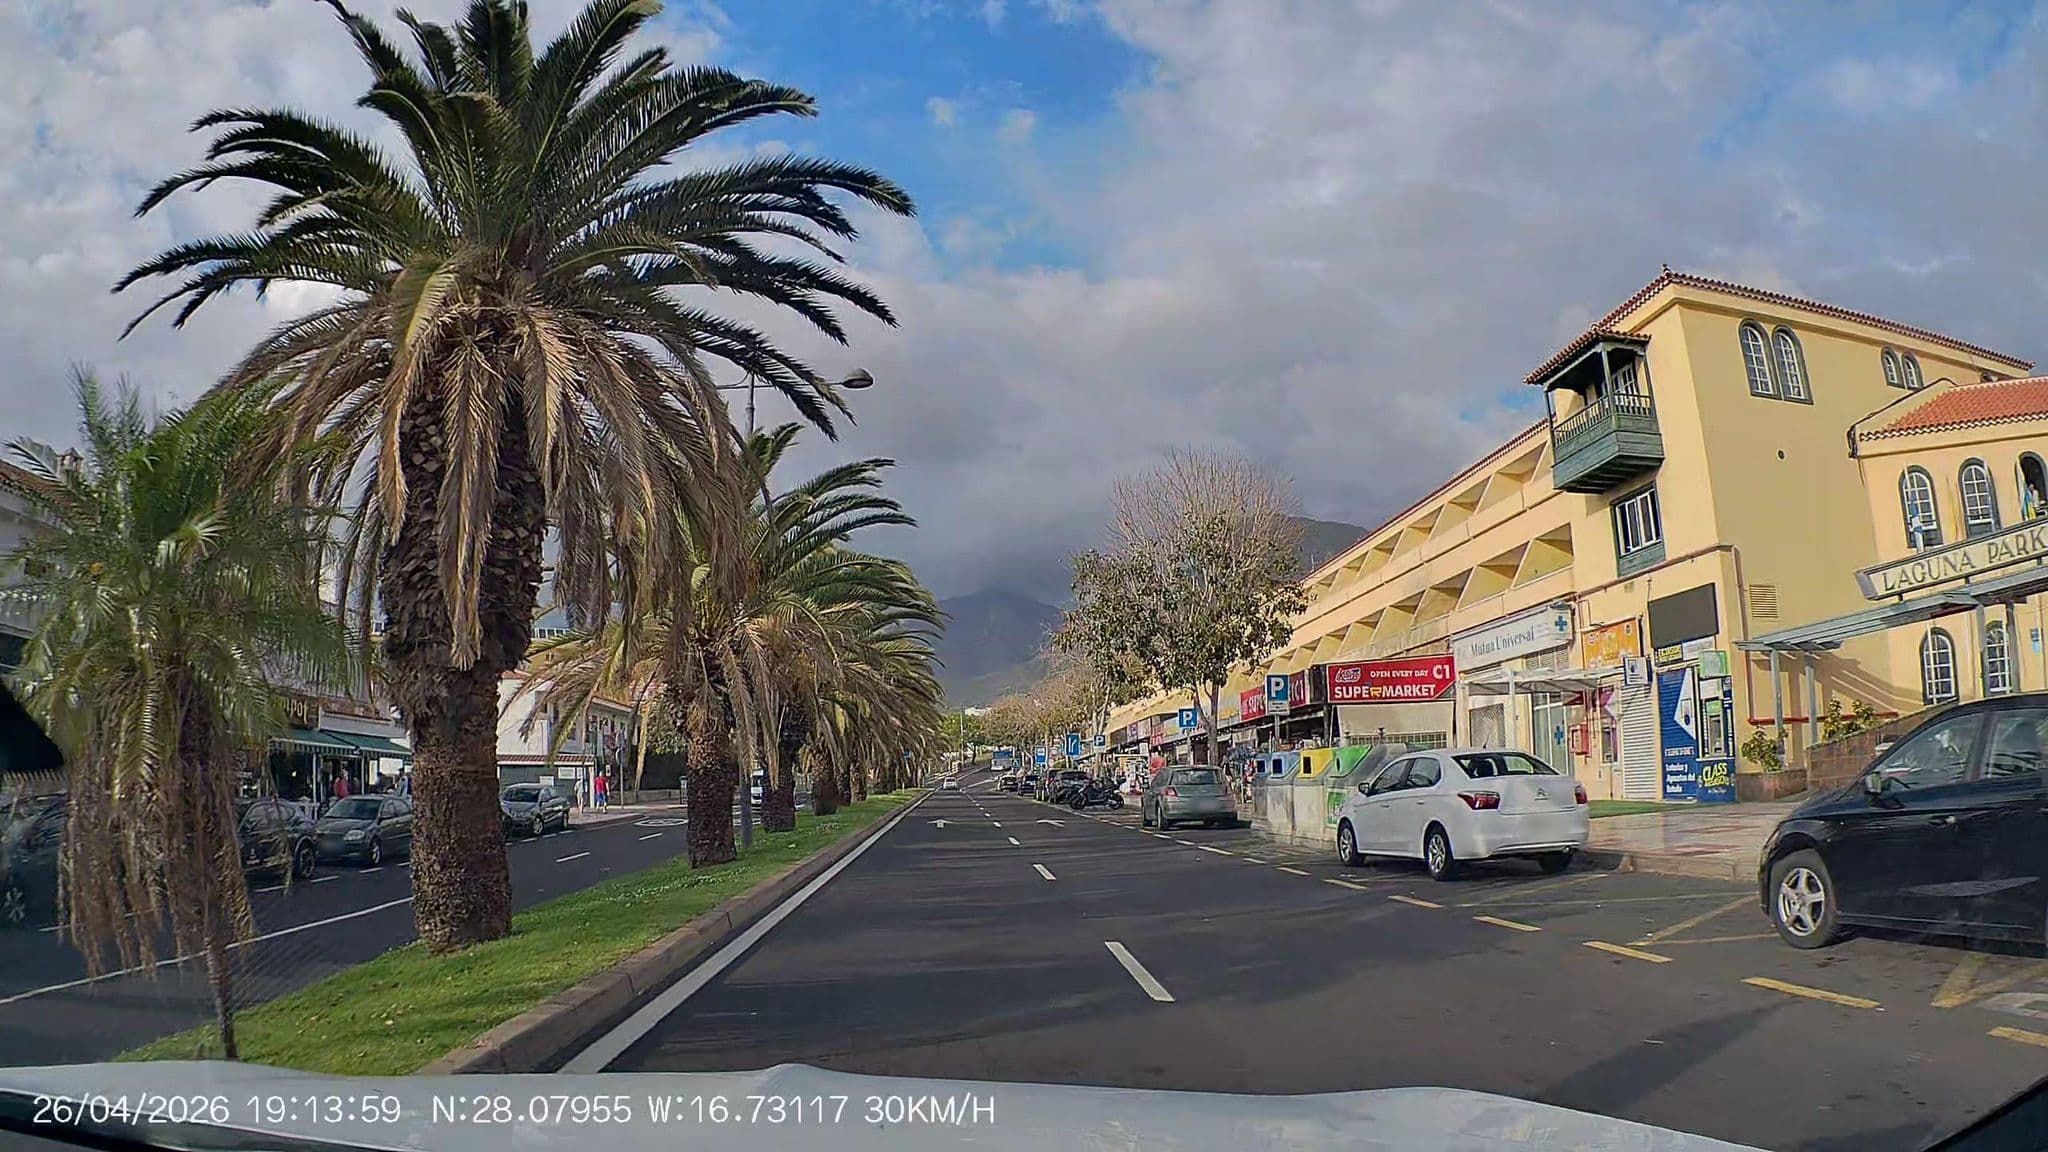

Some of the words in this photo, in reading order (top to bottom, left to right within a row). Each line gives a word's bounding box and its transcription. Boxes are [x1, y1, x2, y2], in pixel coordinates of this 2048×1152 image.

[1882, 549, 1976, 592] LAGUNA
[1987, 526, 2048, 564] PARK
[1471, 638, 1495, 657] Mutua
[1496, 625, 1535, 650] Universal
[1370, 670, 1390, 678] OPEN
[1392, 669, 1413, 678] EVERY
[1432, 664, 1451, 680] C1
[1270, 677, 1285, 698] P
[1334, 684, 1436, 699] SUPERMARKET
[1183, 711, 1194, 726] P
[1095, 736, 1105, 746] P
